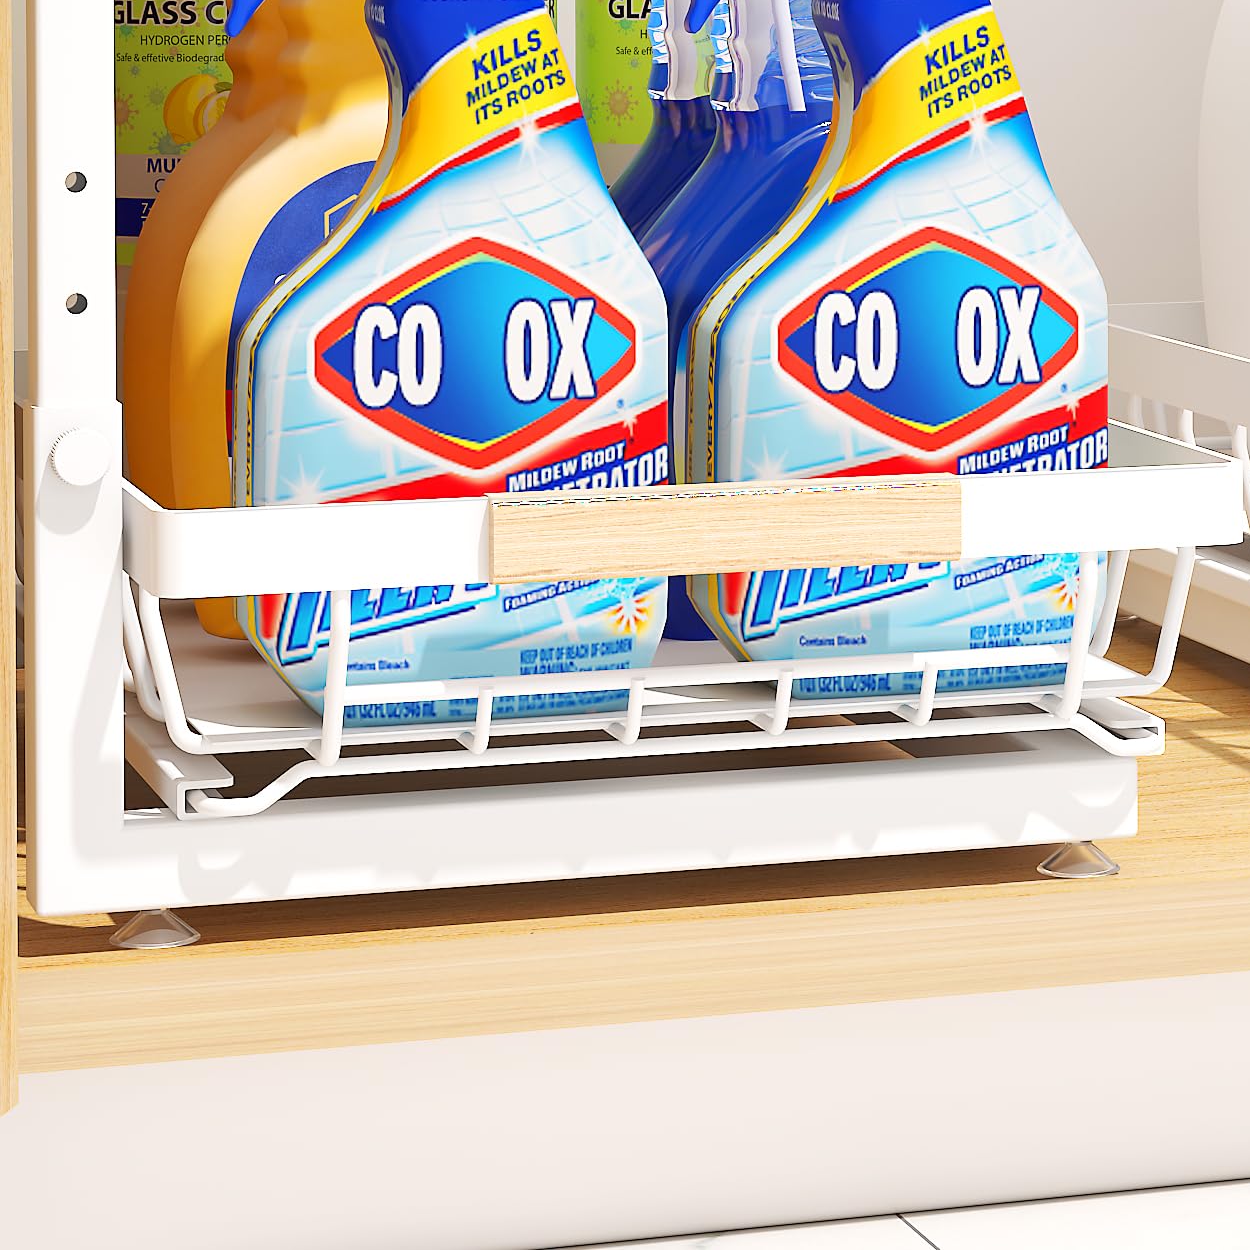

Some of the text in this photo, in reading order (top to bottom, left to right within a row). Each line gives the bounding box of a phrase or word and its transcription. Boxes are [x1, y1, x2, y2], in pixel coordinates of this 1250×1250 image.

[115, 0, 197, 25] GLASS
[116, 53, 132, 62] Safe
[133, 54, 140, 62] &
[141, 53, 175, 62] effetive
[140, 34, 231, 46] HYDROGEN PER
[472, 29, 542, 80] KILLS
[616, 46, 631, 55] Safe
[633, 47, 639, 55] &
[924, 25, 990, 75] KILLS
[466, 48, 559, 107] MILDEW AT
[475, 70, 566, 125] ITS ROOTS
[919, 44, 1005, 101] MILDEW AT
[928, 65, 1012, 118] ITS ROOTS
[352, 302, 443, 408] CO
[504, 297, 597, 403] OX
[813, 289, 899, 394] CO
[955, 286, 1042, 388] OX
[508, 442, 626, 492] MILDEW ROOT
[959, 425, 1069, 475] MILDEW ROOT
[505, 586, 556, 611] FOAMING
[956, 563, 1004, 588] FOAMING
[520, 638, 633, 664] KEEP OUT OF REACH OF CHILDREN
[799, 634, 867, 647] Contains Bleach
[970, 625, 987, 640] KEEP
[988, 624, 1001, 637] OUT
[1003, 623, 1011, 636] OF
[1012, 620, 1034, 636] REACH
[1036, 619, 1044, 634] OF
